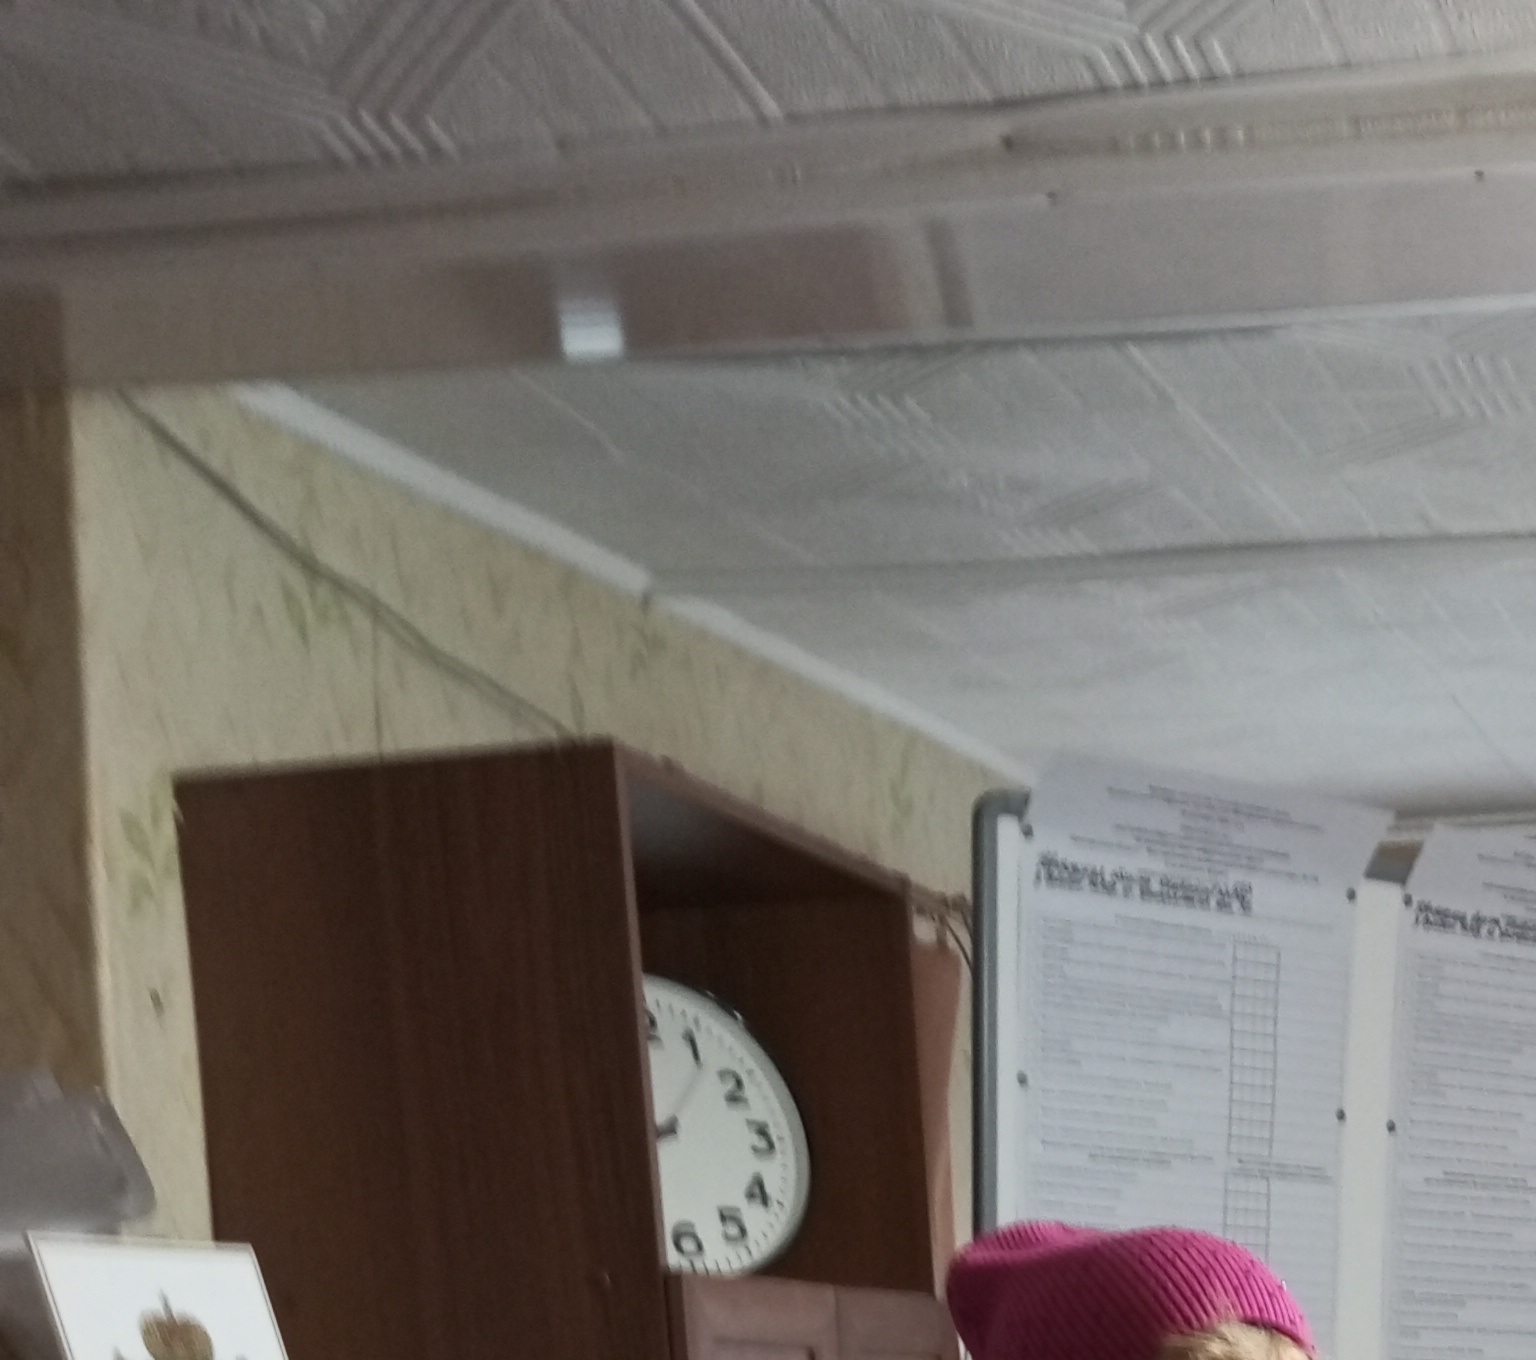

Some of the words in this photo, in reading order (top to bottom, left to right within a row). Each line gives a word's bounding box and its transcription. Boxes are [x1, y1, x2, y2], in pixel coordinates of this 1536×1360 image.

[683, 1028, 702, 1068] 1
[716, 1067, 747, 1110] 2
[745, 1117, 776, 1160] 3
[744, 1172, 771, 1209] 4
[671, 1220, 704, 1256] 6
[717, 1204, 748, 1243] 5
